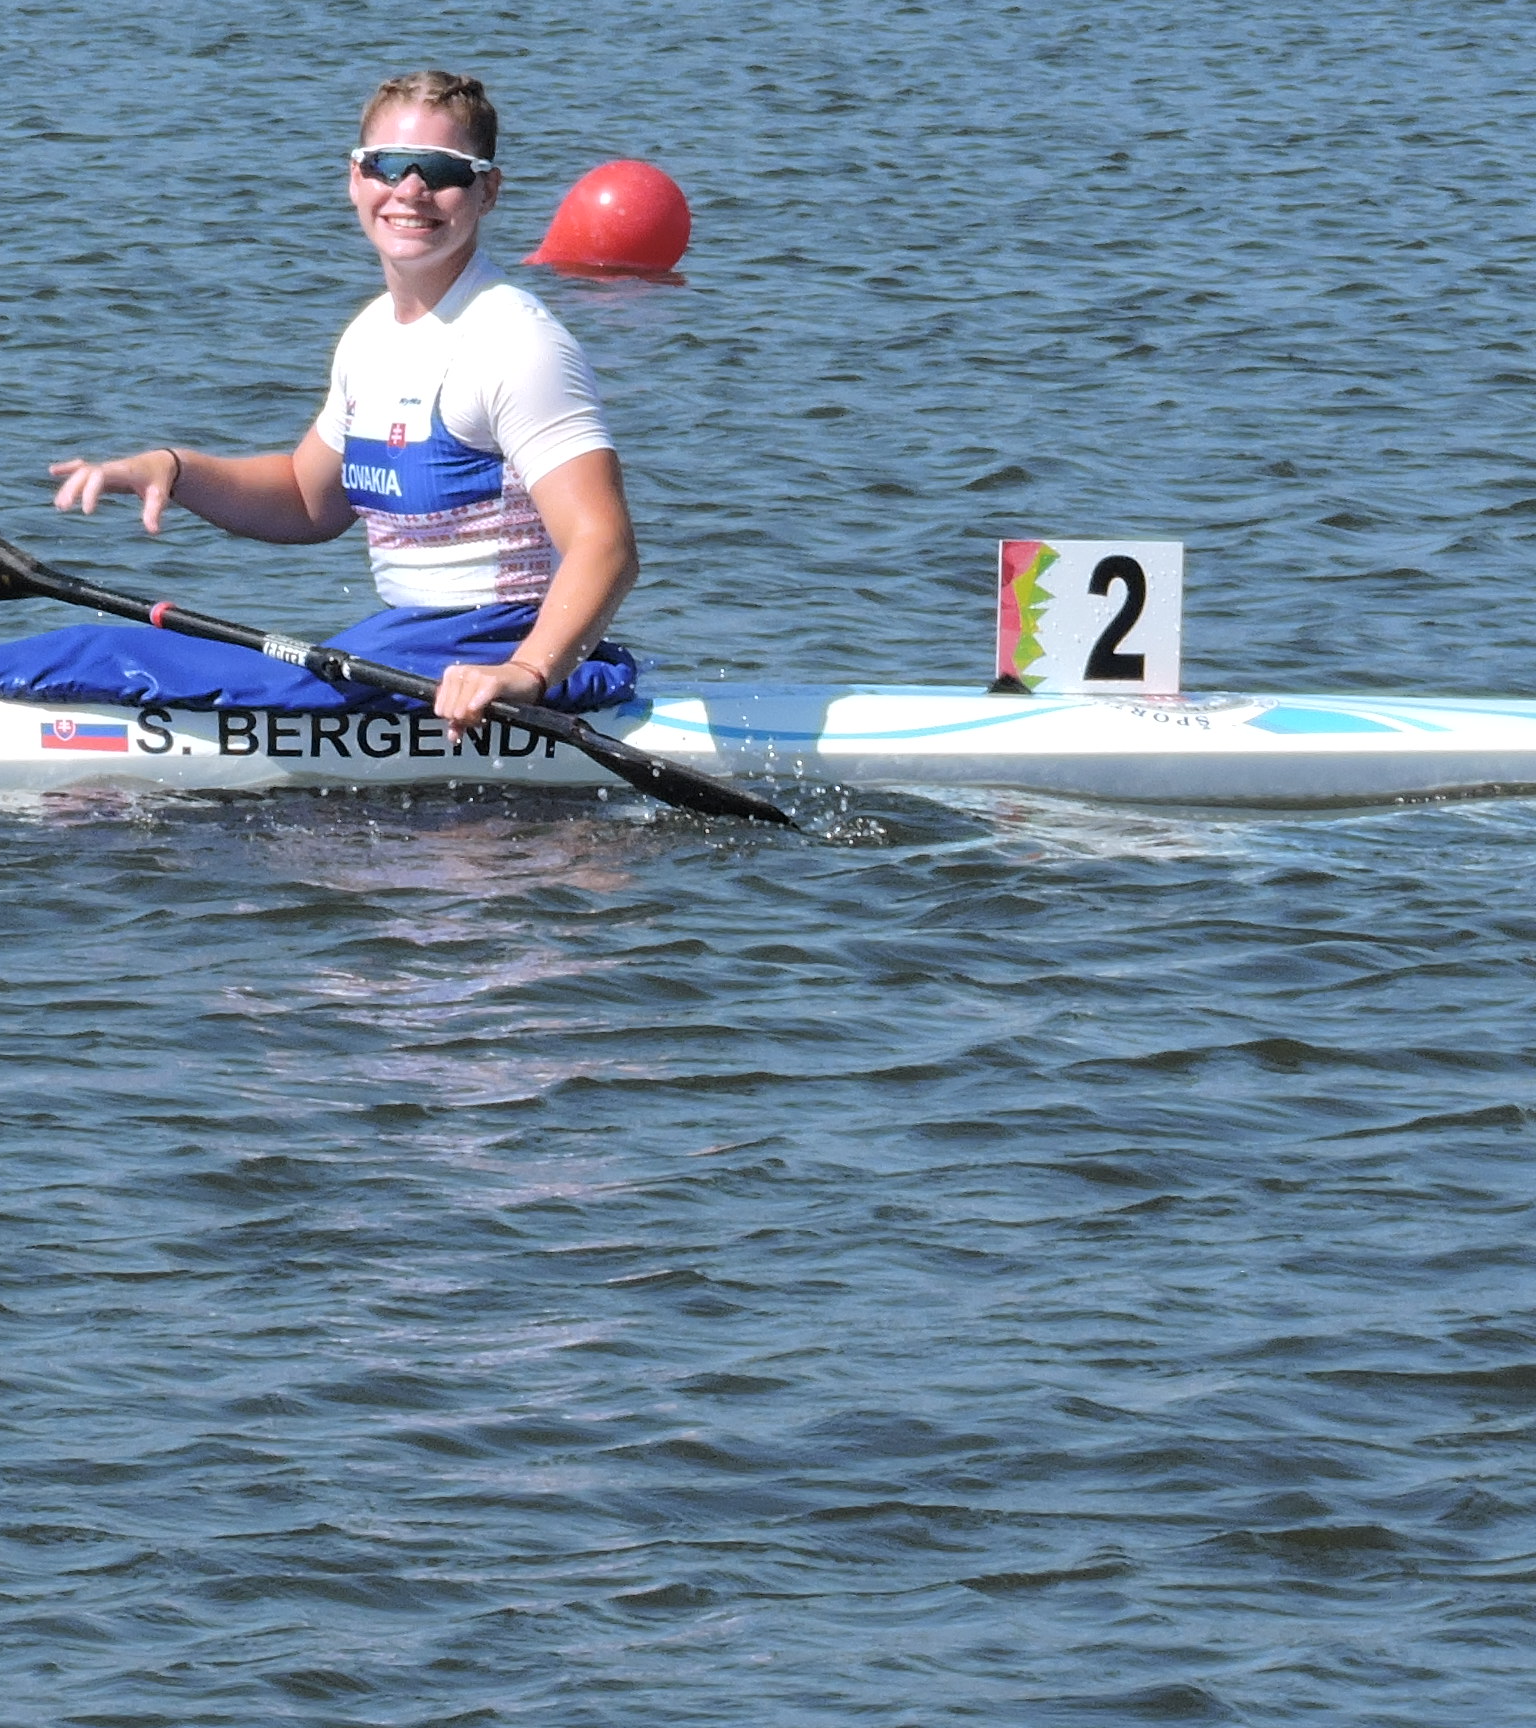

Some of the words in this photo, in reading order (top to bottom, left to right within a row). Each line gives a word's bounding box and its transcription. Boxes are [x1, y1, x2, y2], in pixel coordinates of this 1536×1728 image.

[342, 463, 403, 497] LOVAKIA
[1083, 555, 1147, 681] 2
[136, 707, 192, 756] S.
